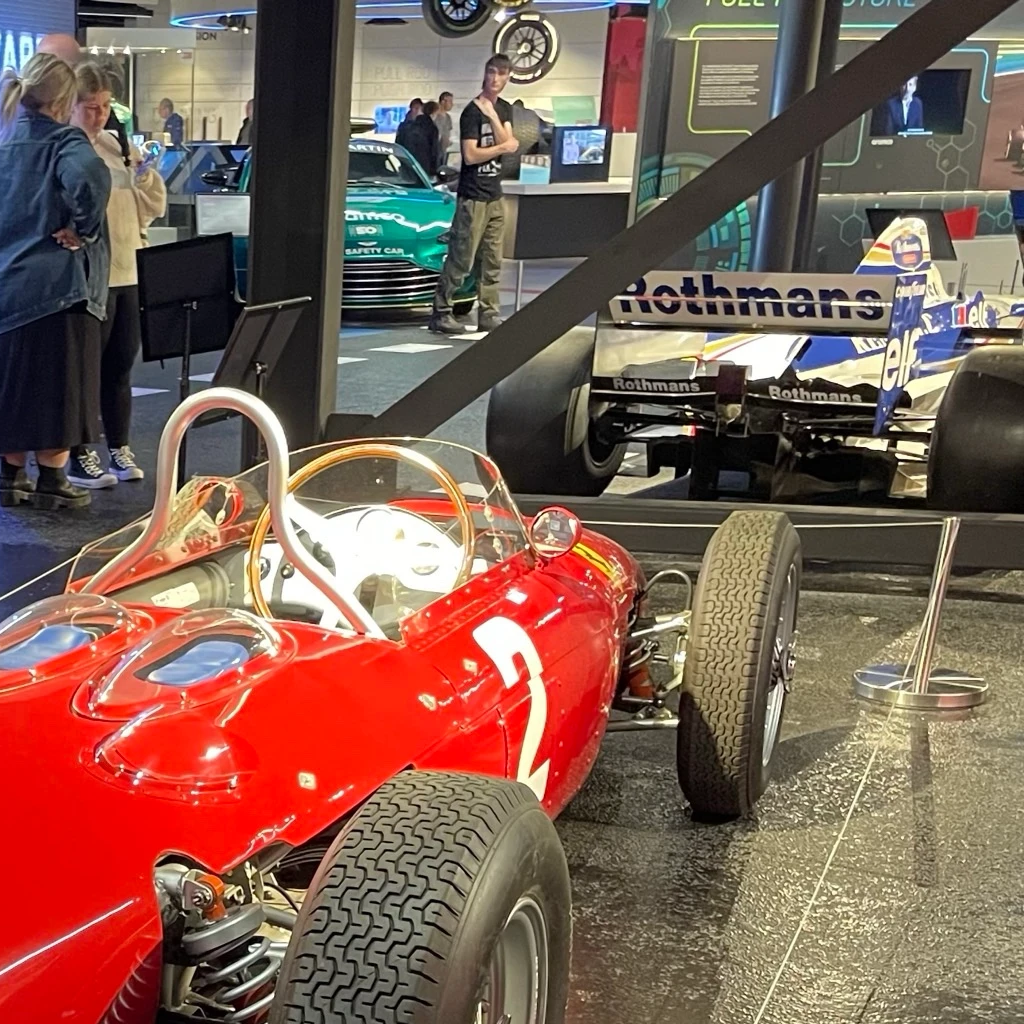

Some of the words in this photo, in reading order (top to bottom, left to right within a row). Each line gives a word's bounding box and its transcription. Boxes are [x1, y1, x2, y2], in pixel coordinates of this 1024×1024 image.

[349, 144, 394, 153] ARTIN
[619, 274, 885, 321] Rothmans
[882, 327, 923, 391] elf
[613, 378, 701, 393] Rothmans
[768, 385, 862, 403] Rothmans
[472, 616, 551, 802] 2
